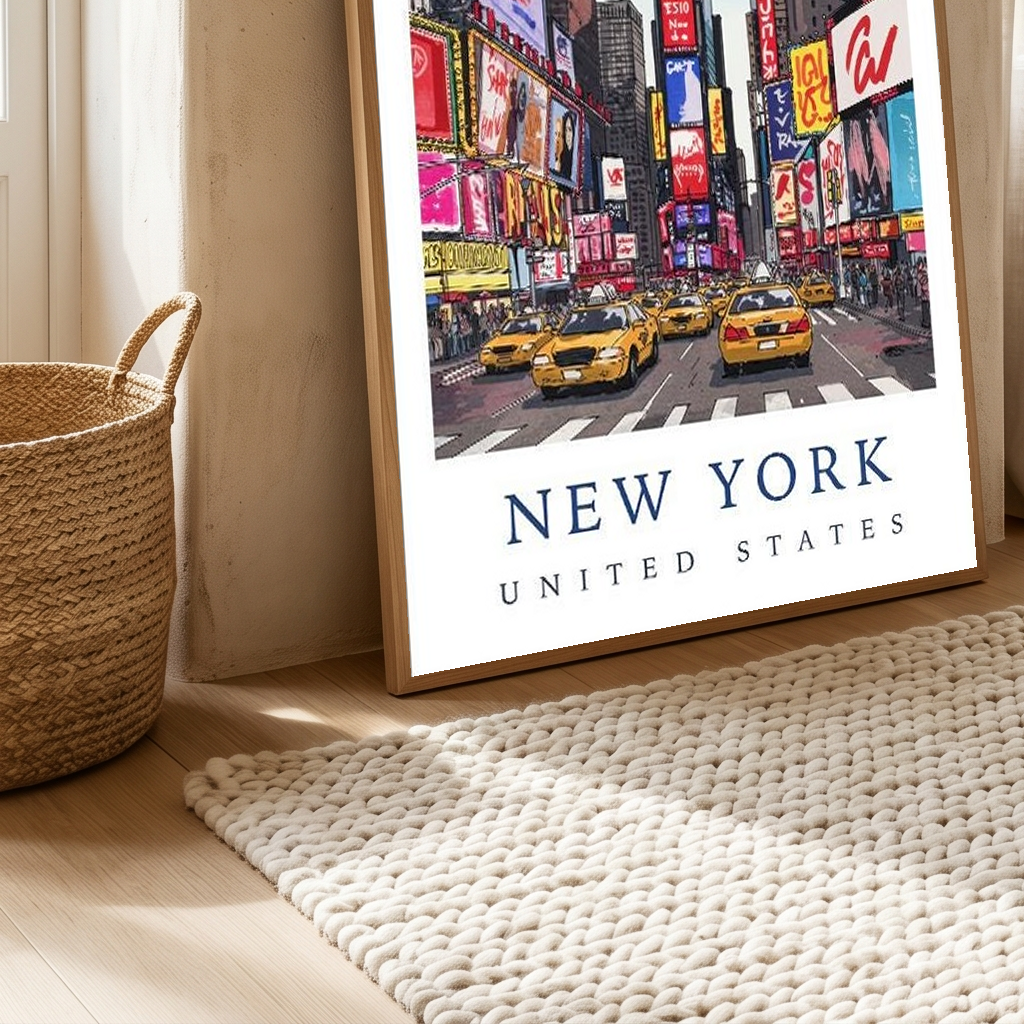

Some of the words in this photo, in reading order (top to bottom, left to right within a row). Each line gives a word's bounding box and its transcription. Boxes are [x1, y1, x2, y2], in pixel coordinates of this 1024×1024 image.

[503, 469, 673, 546] NEW
[707, 435, 893, 511] YORK
[500, 549, 696, 607] UNITED
[736, 512, 905, 563] STATES
